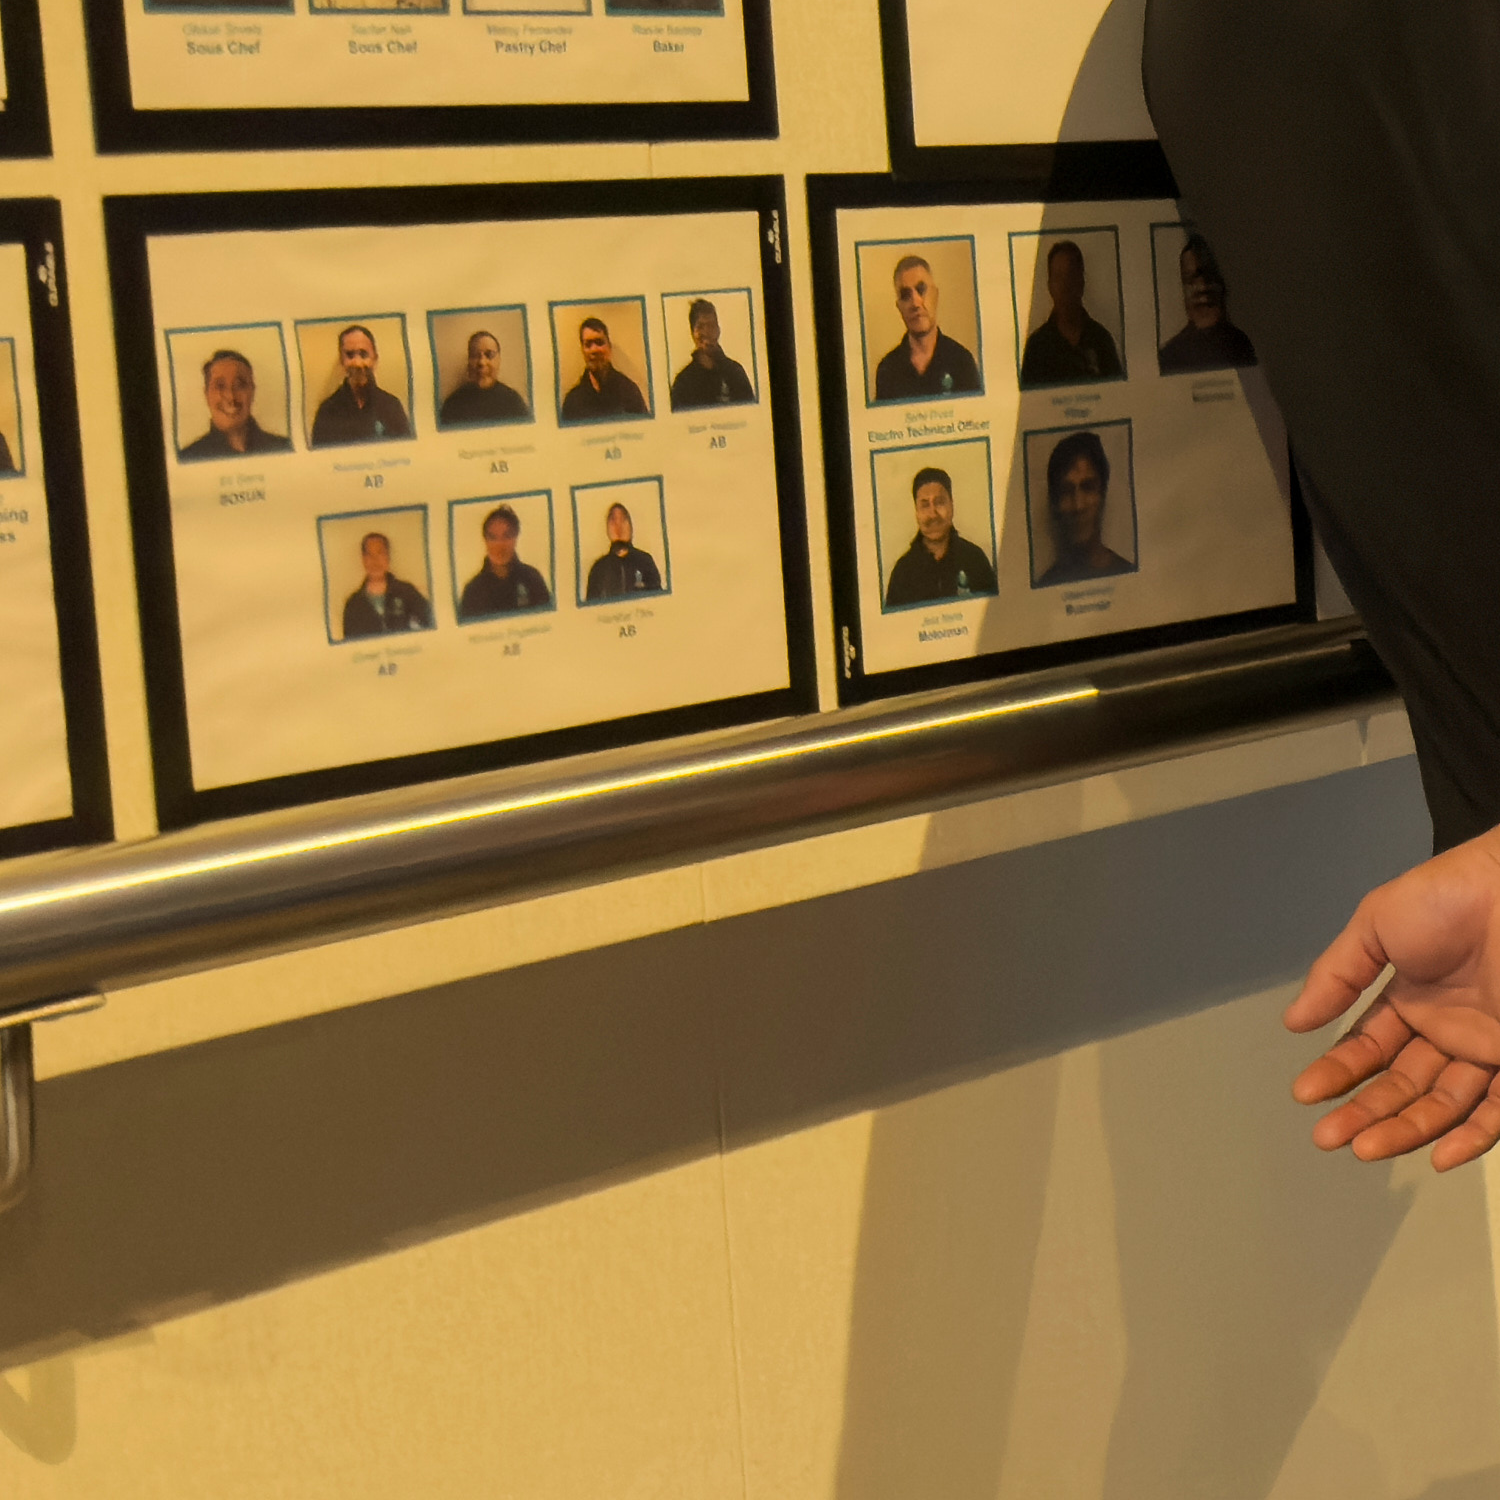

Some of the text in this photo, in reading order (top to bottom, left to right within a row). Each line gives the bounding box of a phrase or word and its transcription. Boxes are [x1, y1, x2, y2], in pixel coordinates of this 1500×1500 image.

[187, 40, 261, 56] Sous Chef
[494, 40, 535, 57] Pastry
[907, 423, 955, 439] Technical
[957, 419, 991, 433] Officer
[709, 435, 727, 449] AB
[489, 460, 509, 474] AB
[364, 474, 384, 489] AB
[618, 624, 637, 639] AB
